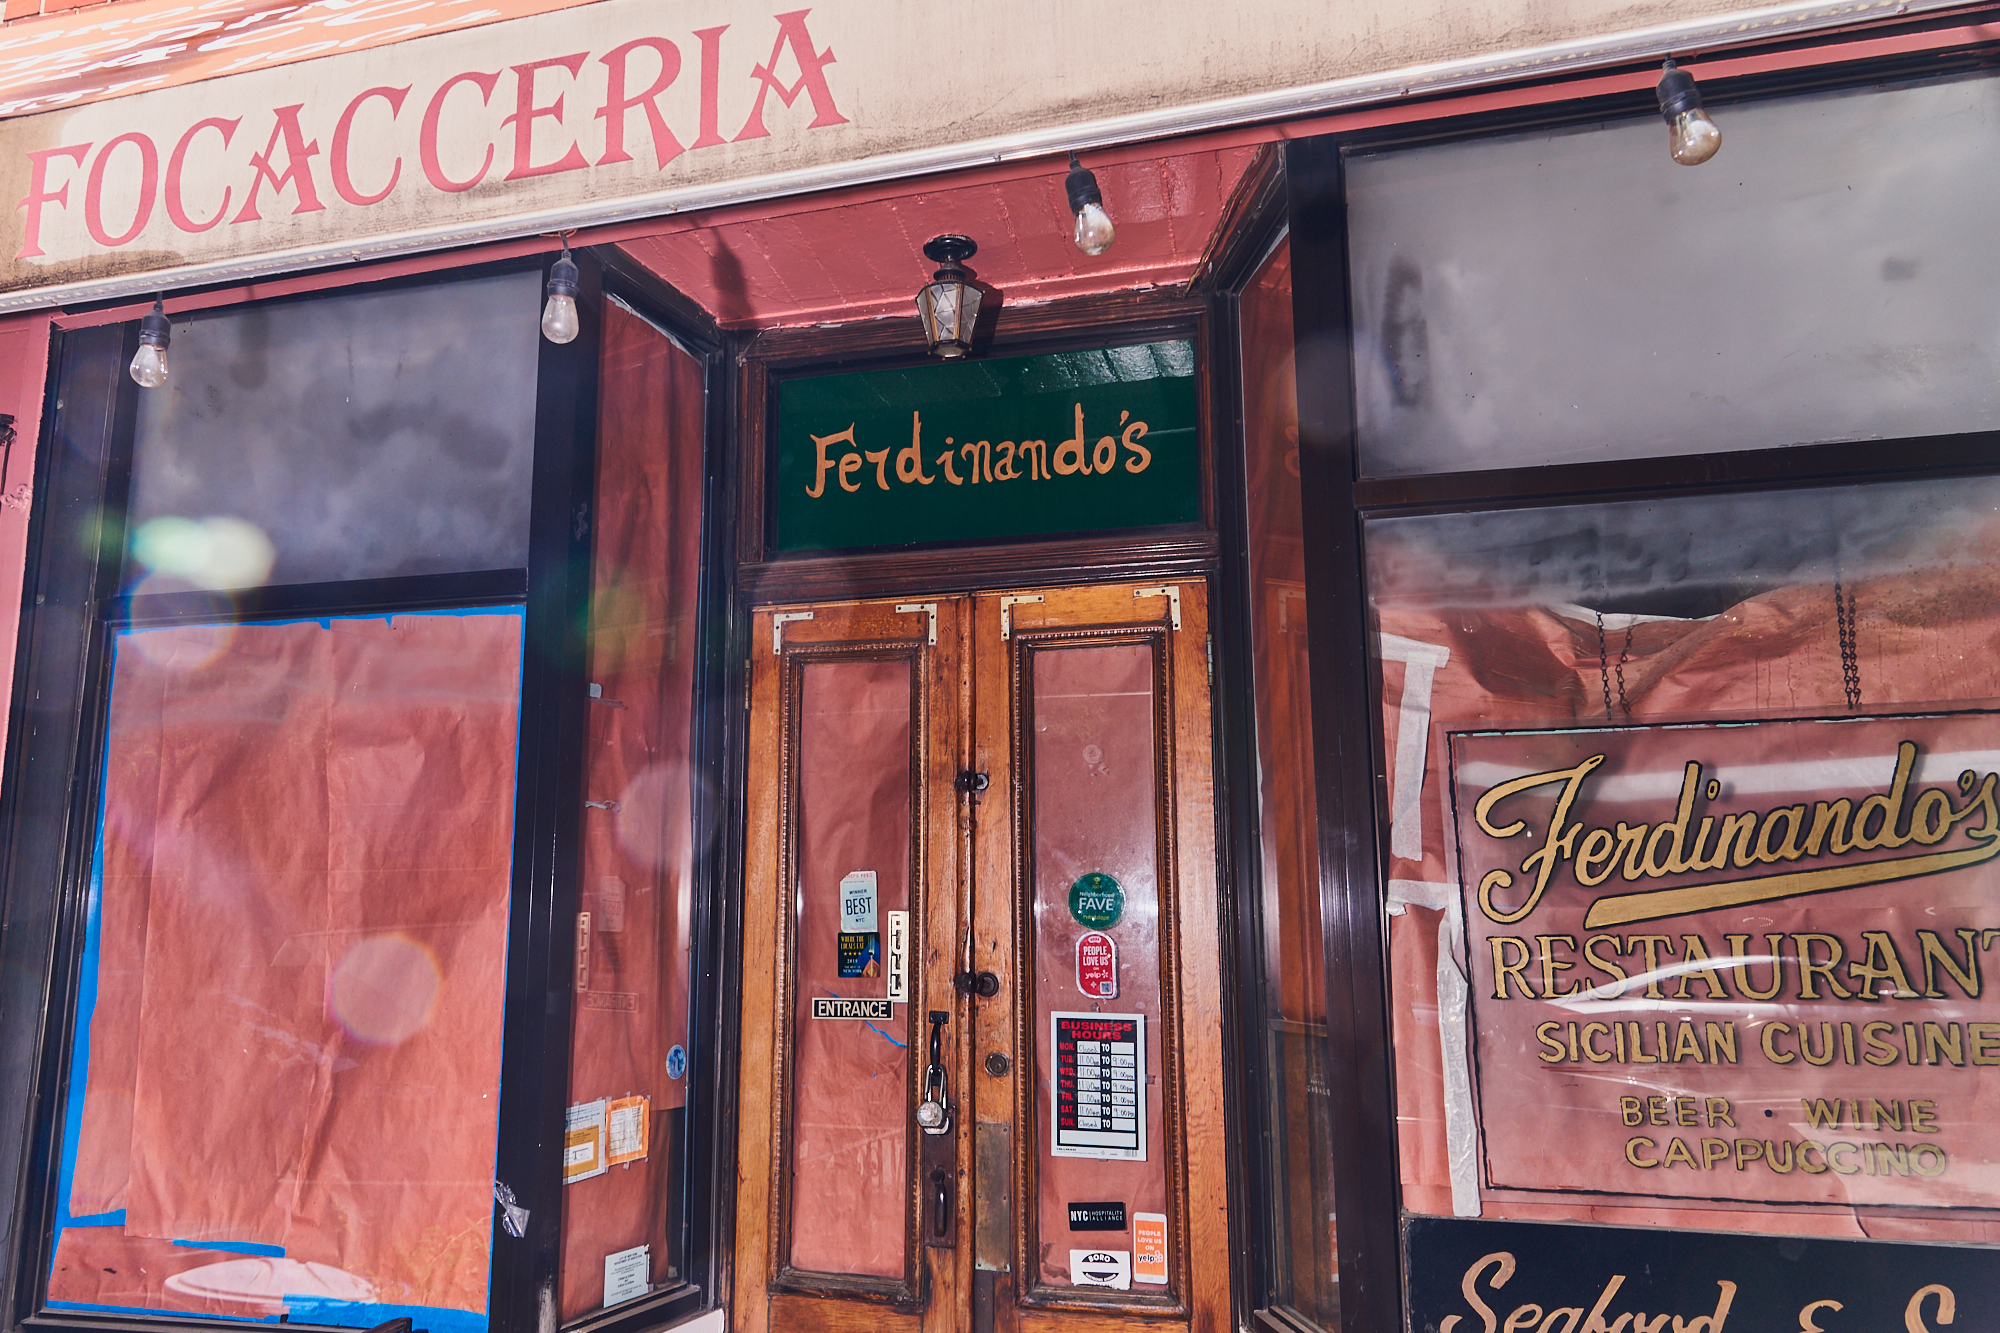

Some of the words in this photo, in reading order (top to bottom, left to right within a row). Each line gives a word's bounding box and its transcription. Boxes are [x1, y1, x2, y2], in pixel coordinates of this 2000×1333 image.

[15, 8, 850, 261] FOCACCERIA
[805, 402, 1152, 498] Ferdinando's
[1474, 740, 1999, 925] Ferdinando's
[845, 896, 872, 916] BEST
[1078, 897, 1114, 911] FAVE
[891, 915, 903, 995] PULL
[1083, 946, 1107, 956] PEOPLE
[1083, 956, 1099, 966] LOVE
[1100, 956, 1109, 966] US
[1085, 971, 1102, 980] yelp
[818, 1000, 888, 1018] ENTRANCE
[1061, 1021, 1133, 1032] BUSINESS
[1071, 1030, 1122, 1041] HOURS
[1102, 1043, 1110, 1053] TO
[1536, 1020, 1739, 1065] SICILIAN
[1760, 1020, 2000, 1067] CUISINE
[1102, 1056, 1111, 1065] TO
[1102, 1068, 1111, 1078] TO
[1102, 1081, 1111, 1090] TO
[1102, 1093, 1111, 1103] TO
[1102, 1106, 1111, 1115] TO
[1619, 1095, 1736, 1129] BEER
[1801, 1097, 1939, 1133] WINE
[1102, 1119, 1111, 1128] TO
[1624, 1136, 1947, 1178] CAPPUCCINO
[1070, 1210, 1089, 1222] NYC
[1138, 1229, 1161, 1237] PEOPLE
[1137, 1236, 1153, 1244] LOVE
[1087, 1253, 1111, 1263] BORO
[1137, 1253, 1155, 1263] yelp
